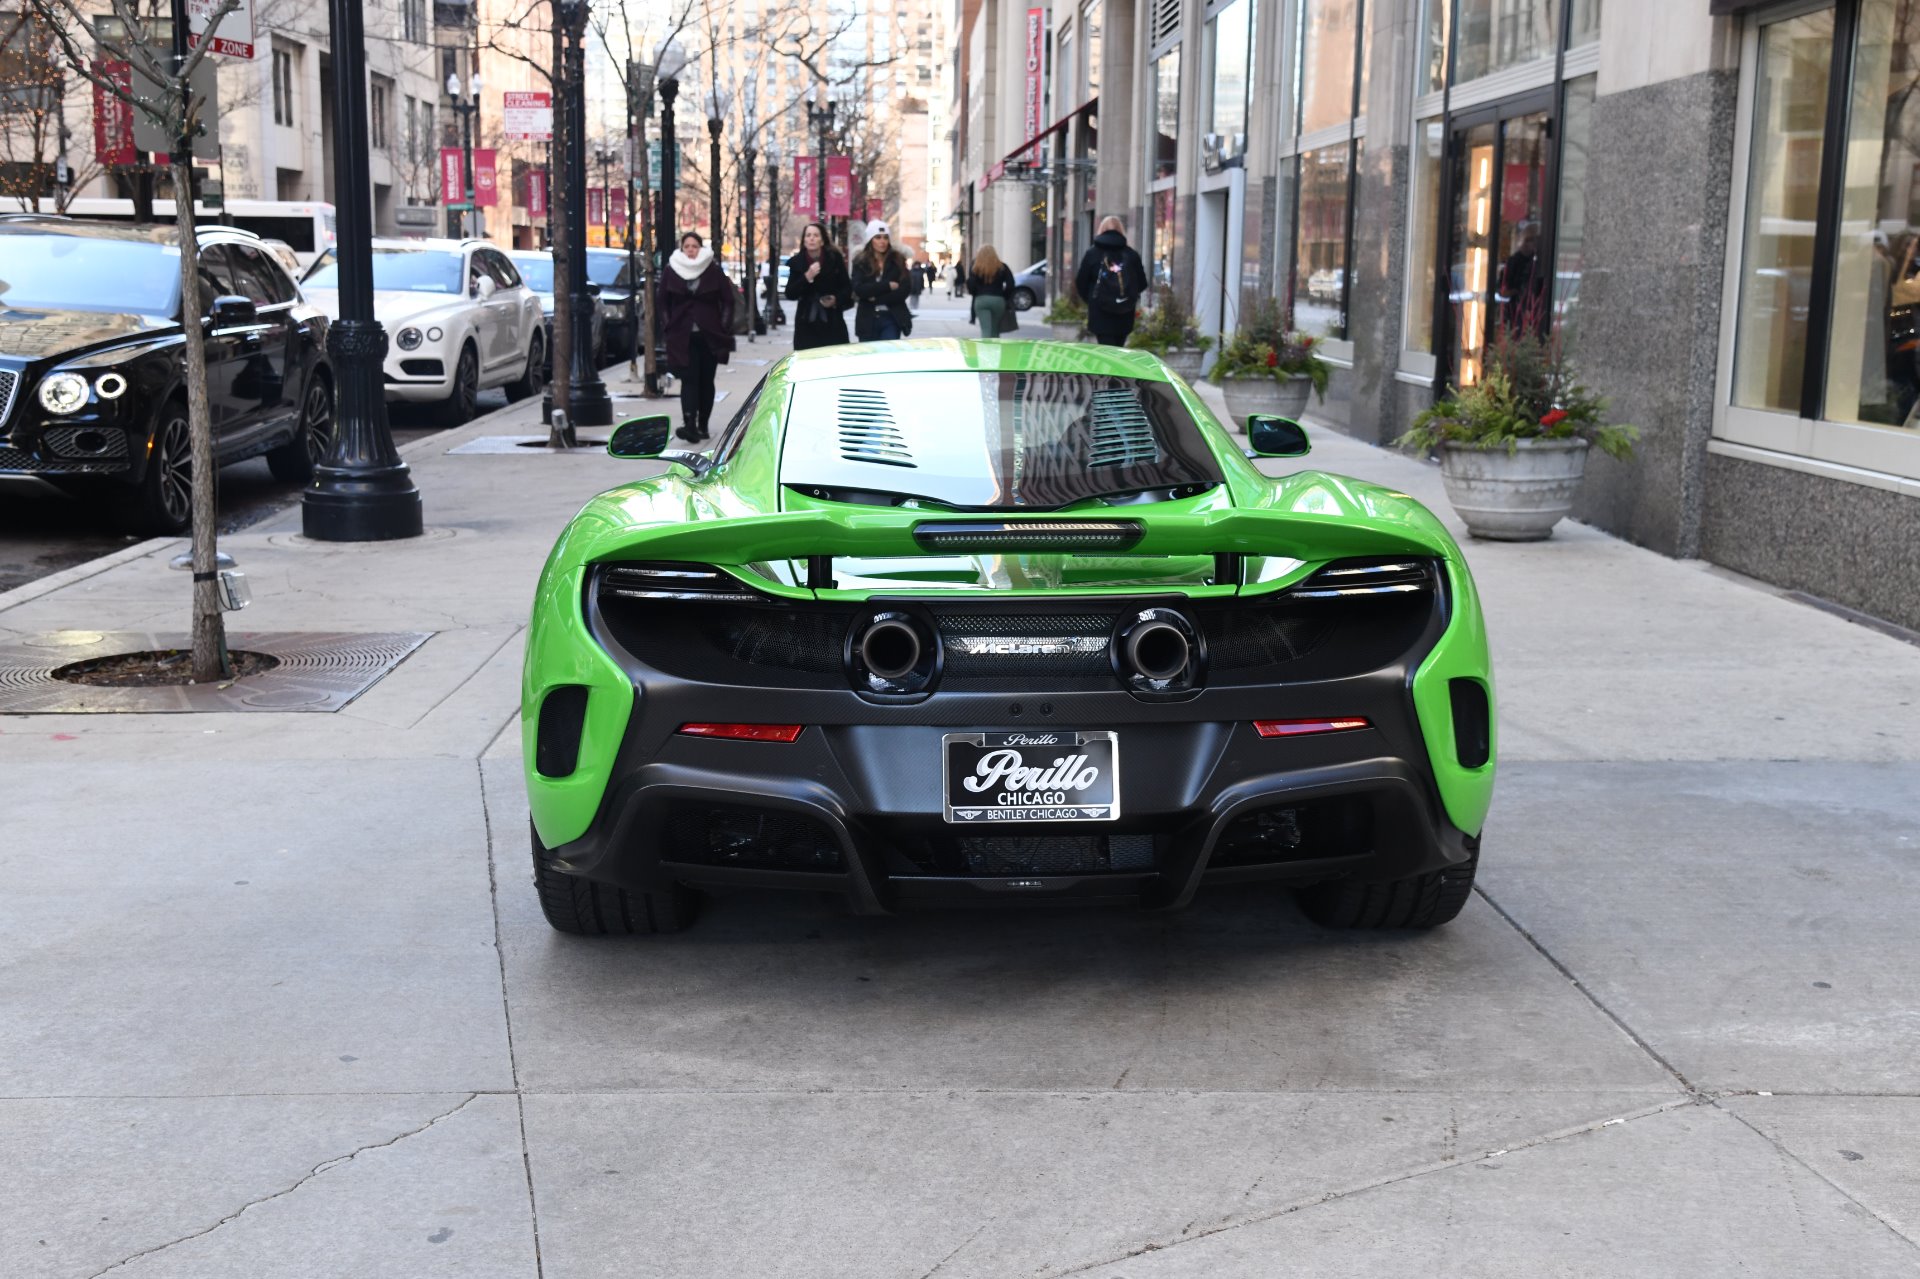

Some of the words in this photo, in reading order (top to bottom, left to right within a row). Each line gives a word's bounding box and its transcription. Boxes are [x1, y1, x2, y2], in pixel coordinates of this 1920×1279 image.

[191, 34, 216, 51] TW
[220, 40, 249, 57] ZONE
[1026, 15, 1037, 71] EPIC
[506, 93, 533, 101] STREET
[446, 155, 456, 199] WELCOME
[530, 175, 538, 212] WELCOME
[970, 643, 1070, 654] McLaren
[1003, 733, 1058, 746] Perillo
[963, 749, 1099, 793] Perillo
[997, 791, 1066, 805] CHICAGO
[987, 809, 1027, 820] BENTLEY
[1029, 808, 1078, 819] CHICAGO
